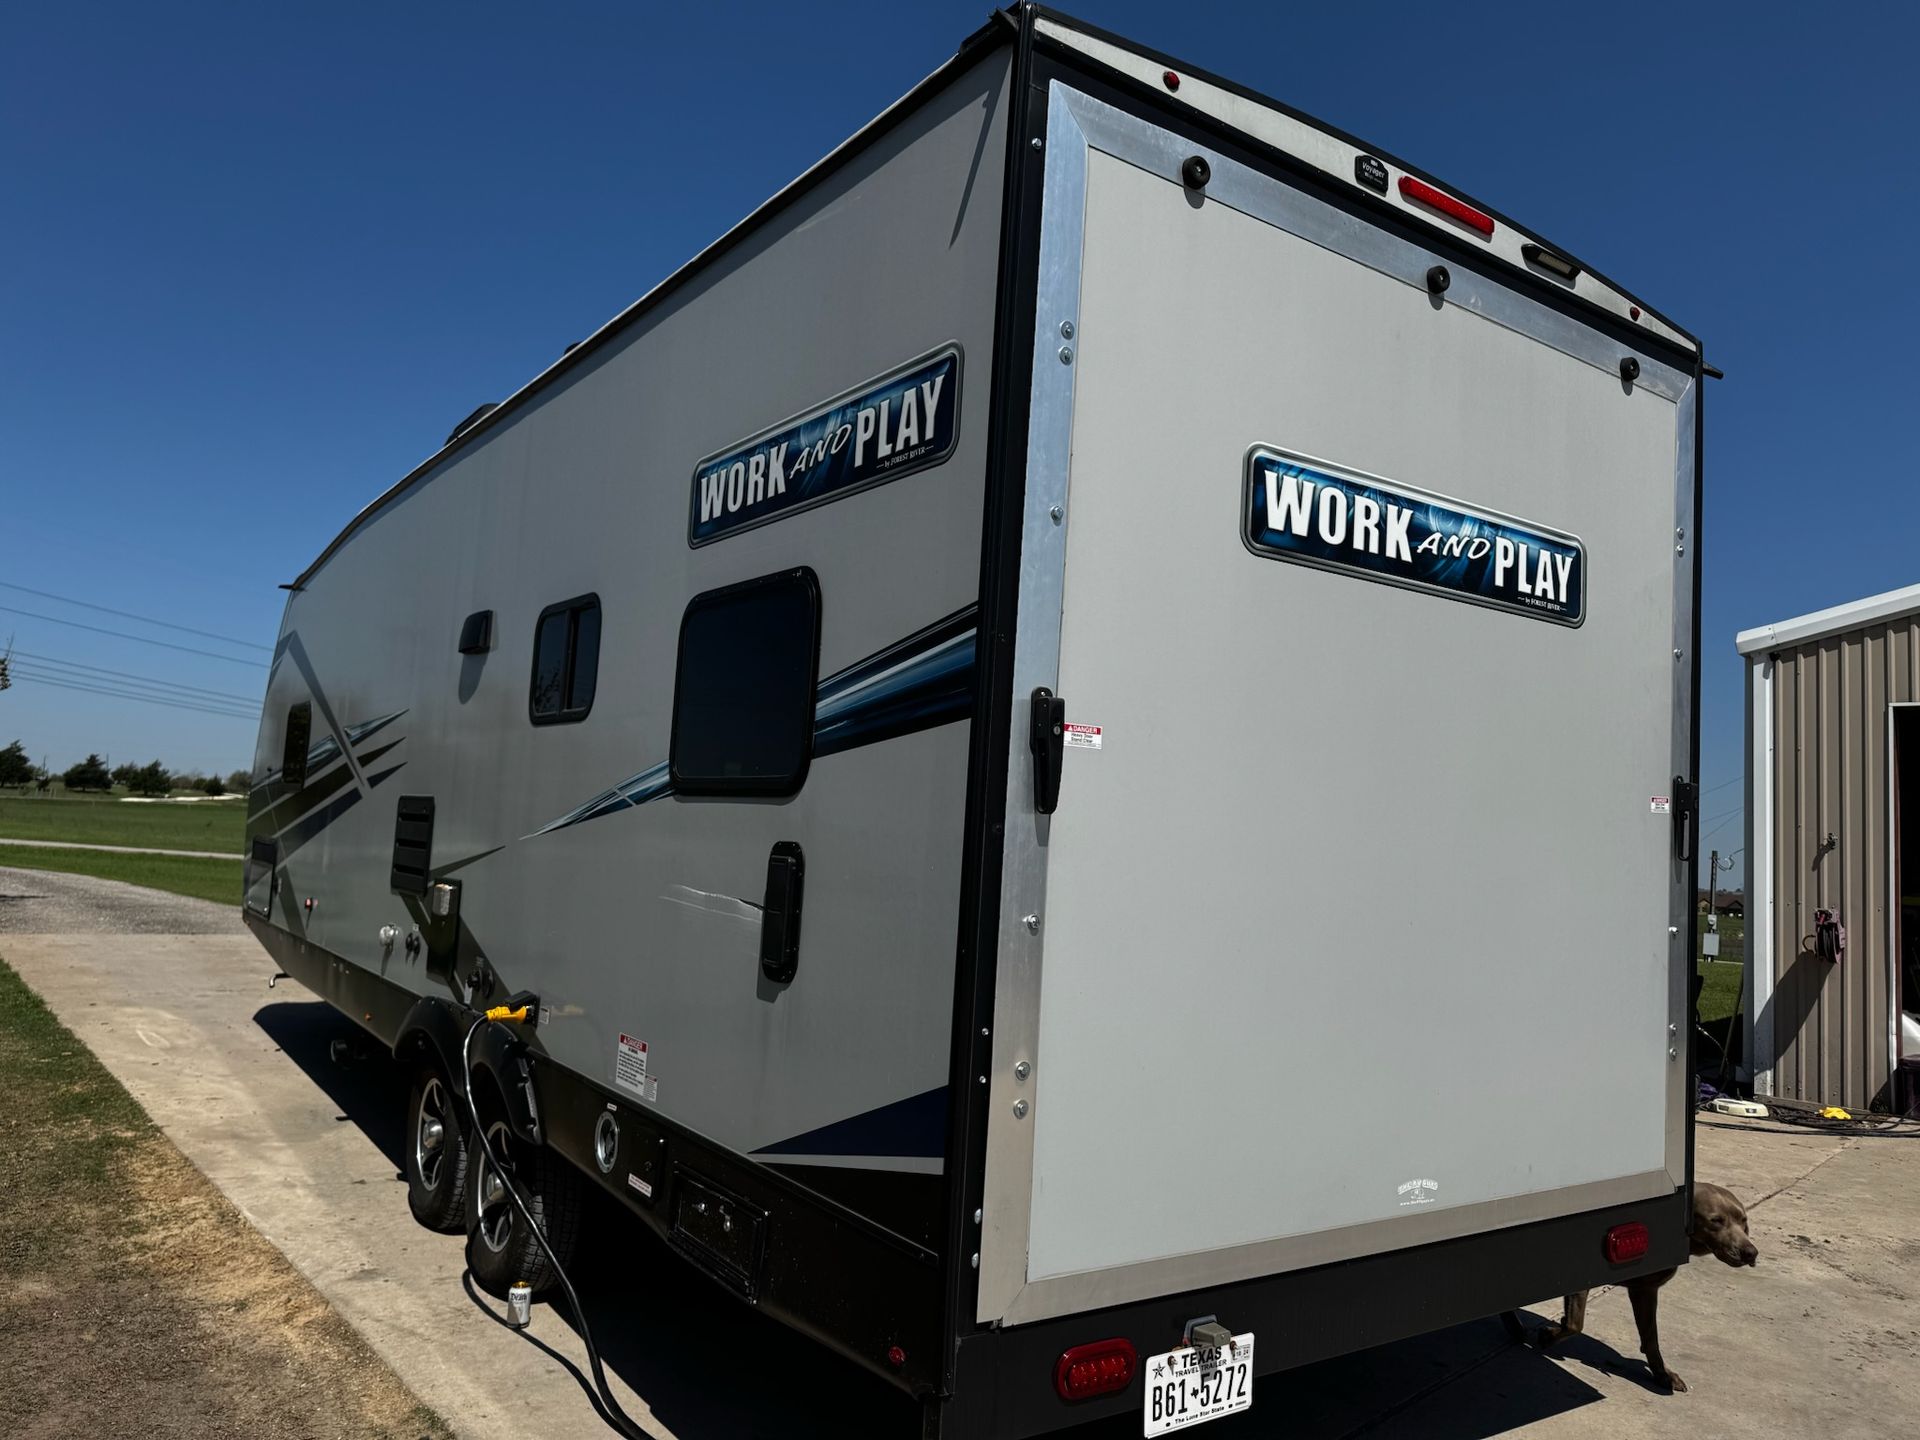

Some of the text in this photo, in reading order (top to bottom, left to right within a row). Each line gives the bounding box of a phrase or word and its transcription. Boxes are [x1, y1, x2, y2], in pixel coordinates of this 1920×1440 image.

[1362, 161, 1385, 178] Voyager
[700, 374, 945, 523] WORK AND PLAY
[890, 452, 909, 466] FOREST
[1264, 470, 1574, 604] WORK AND PLAY
[1073, 726, 1098, 734] DANGER
[1182, 1346, 1222, 1368] TEXAS
[1175, 1359, 1227, 1378] TRAVEL TRAILER
[1152, 1363, 1247, 1422] B61 5272
[1211, 1406, 1225, 1414] State
